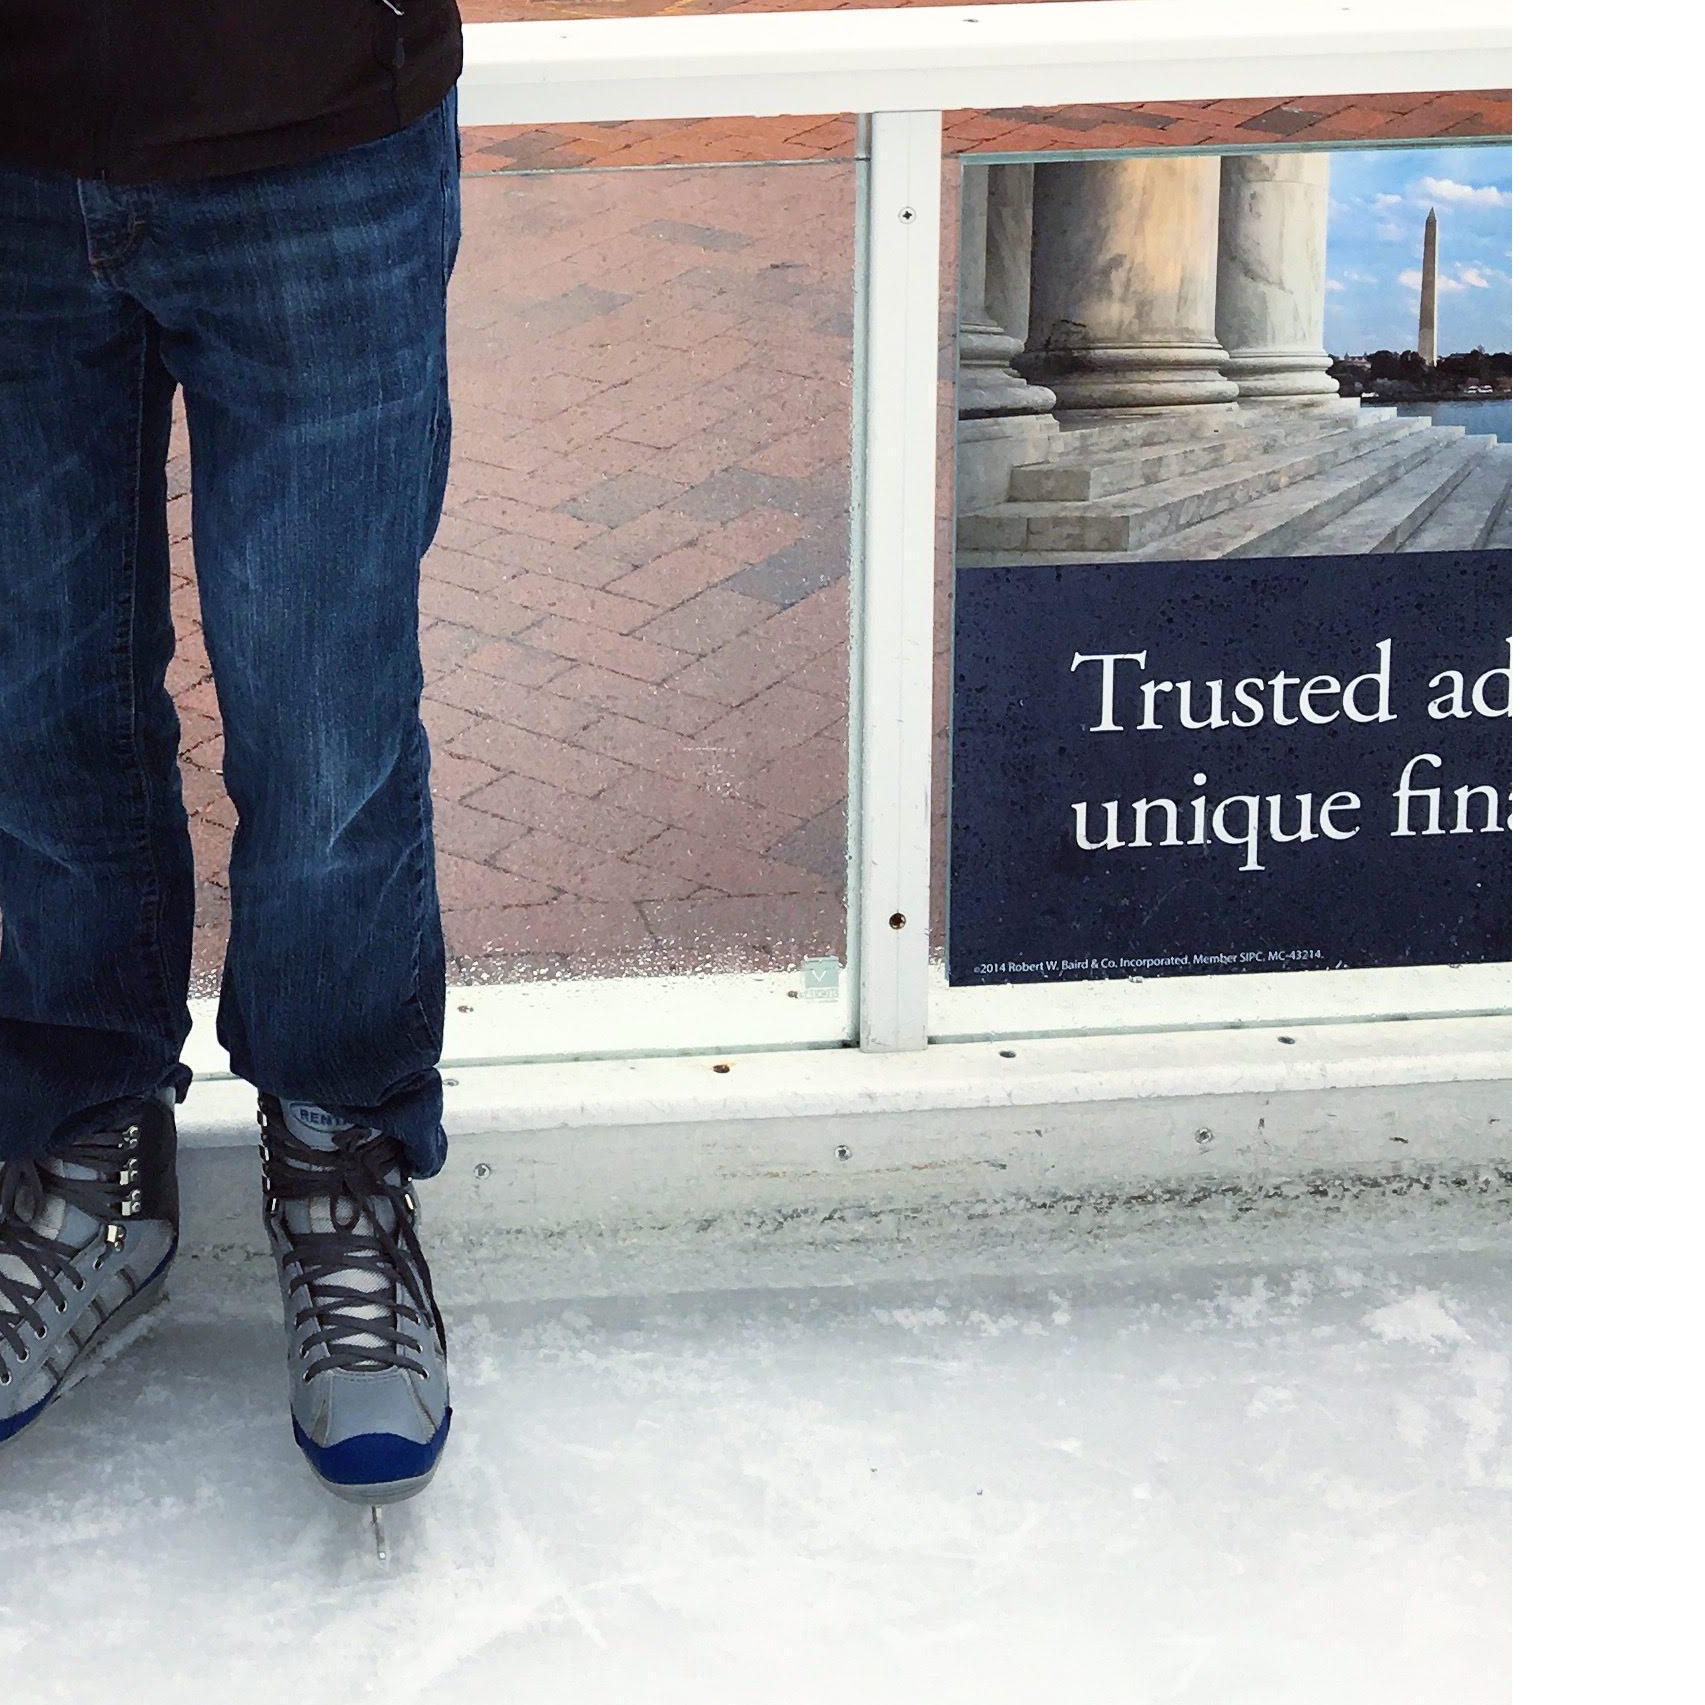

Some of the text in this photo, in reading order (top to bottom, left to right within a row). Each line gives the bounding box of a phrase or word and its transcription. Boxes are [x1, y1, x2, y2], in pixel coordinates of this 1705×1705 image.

[1070, 637, 1398, 732] Trusted
[1071, 753, 1513, 871] unique fin
[1008, 961, 1044, 972] Robert
[1046, 961, 1059, 971] W.
[1061, 959, 1089, 970] Baird
[1090, 959, 1099, 969] &
[1100, 958, 1118, 969] Co.
[1119, 954, 1191, 968] Incorporated.
[1193, 953, 1238, 965] Member
